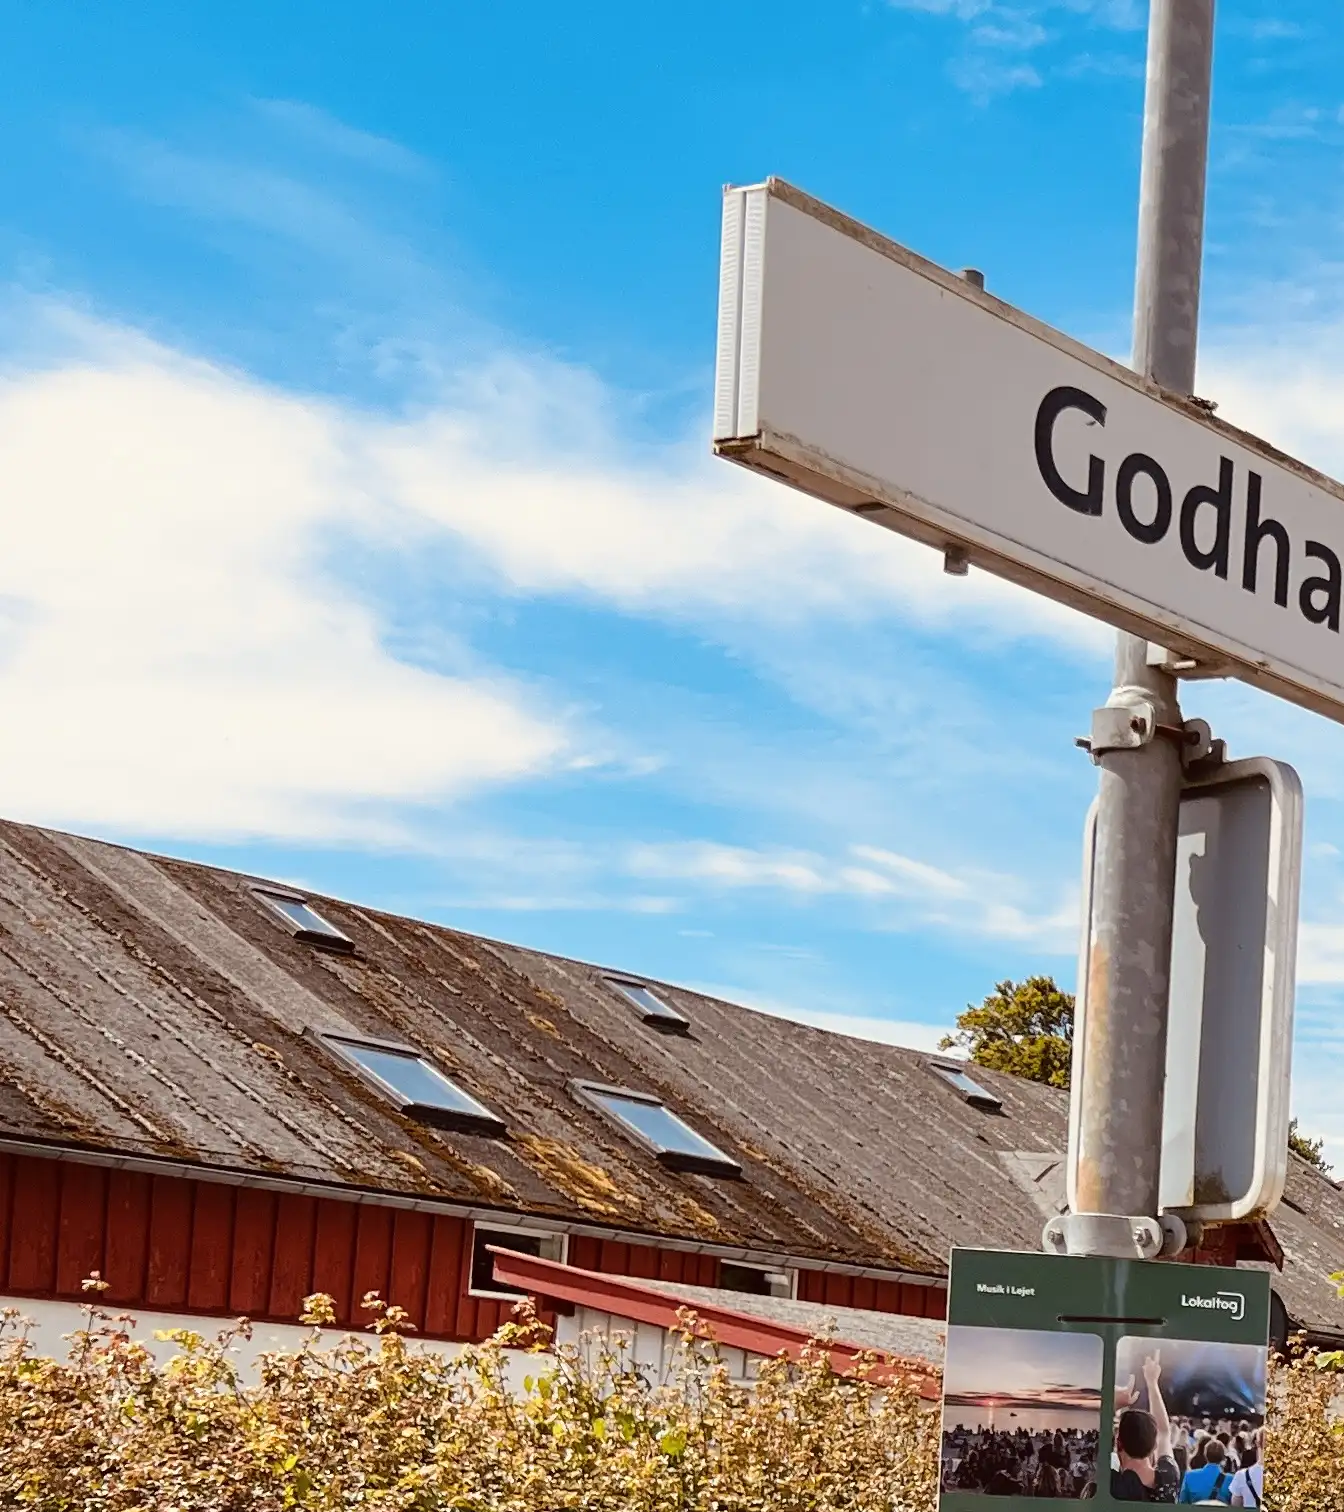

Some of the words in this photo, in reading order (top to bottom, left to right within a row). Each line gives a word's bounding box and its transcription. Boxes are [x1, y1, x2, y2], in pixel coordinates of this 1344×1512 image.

[976, 1284, 1005, 1294] Musik
[1011, 1286, 1036, 1297] Lejet
[1181, 1294, 1238, 1313] Lokaltog
